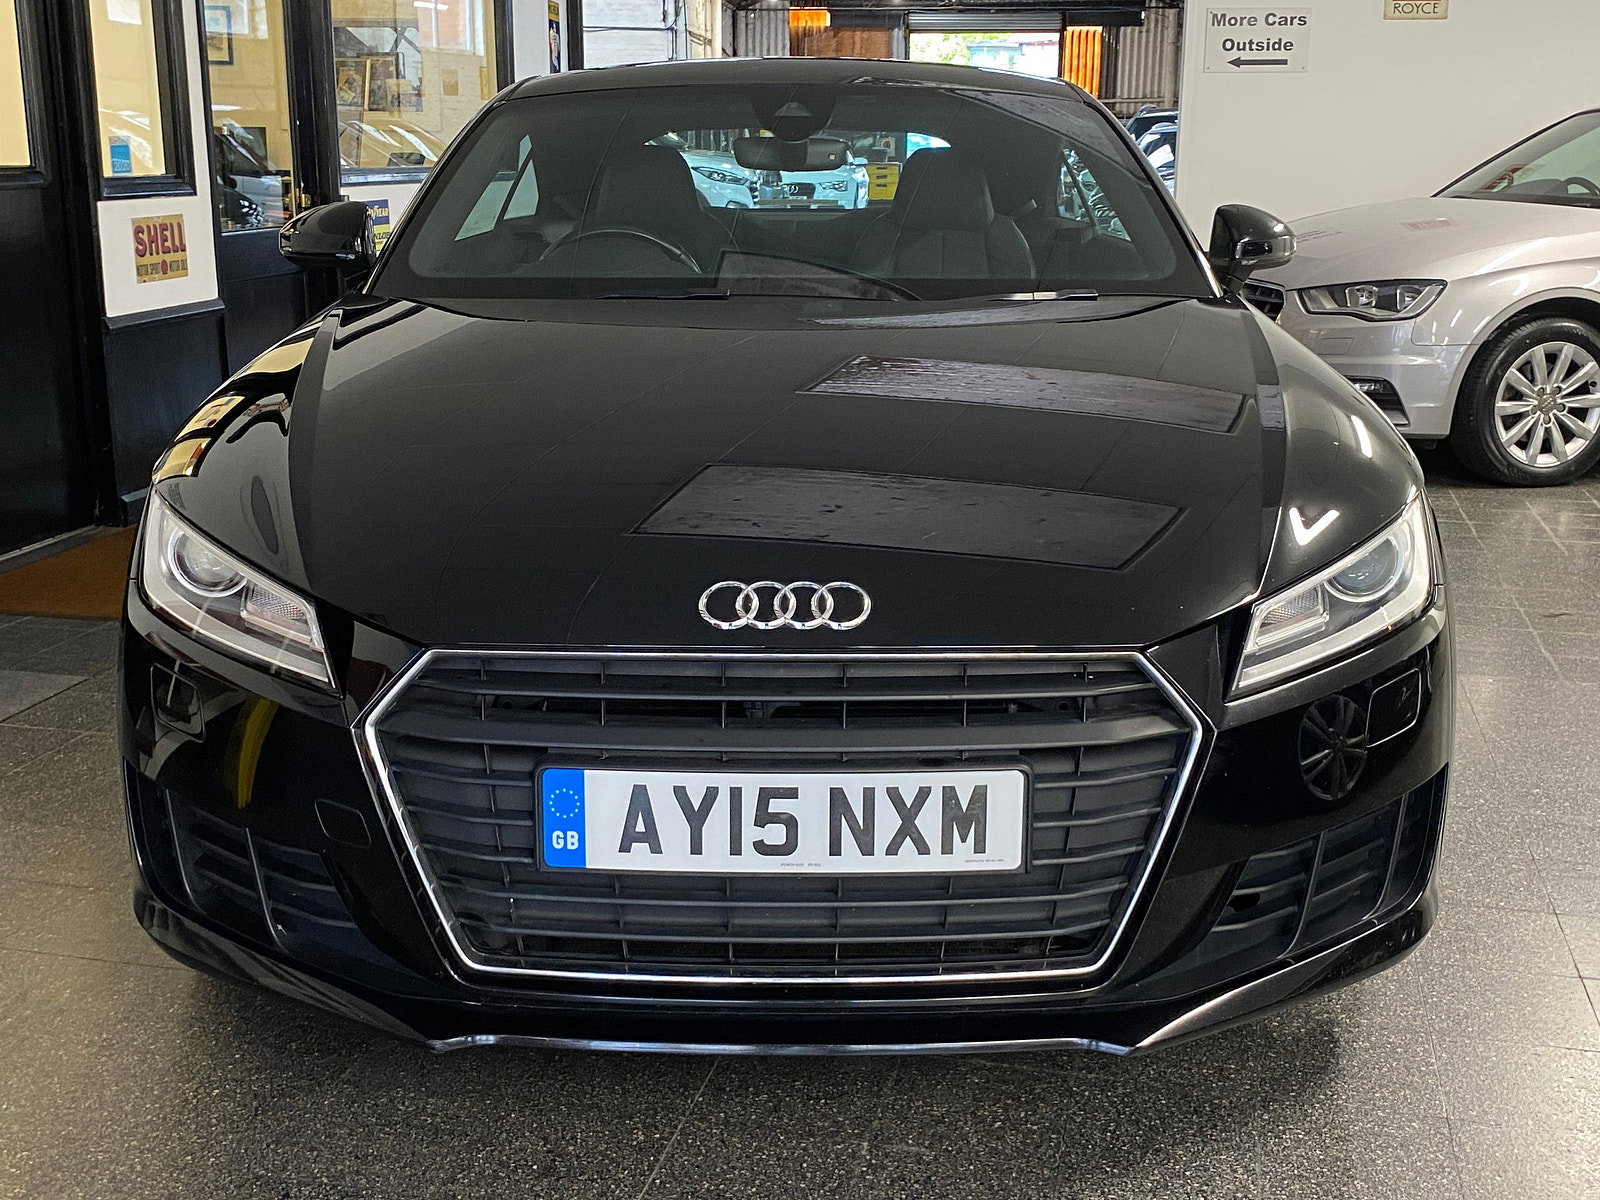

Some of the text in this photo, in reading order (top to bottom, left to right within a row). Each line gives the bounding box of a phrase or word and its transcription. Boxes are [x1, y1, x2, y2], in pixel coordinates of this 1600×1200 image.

[1393, 2, 1439, 14] ROYCE
[1211, 12, 1308, 27] More Cars
[1221, 38, 1294, 52] Outside
[134, 222, 186, 257] SHELL
[618, 784, 988, 857] AY15 NXM
[552, 830, 579, 850] GB
